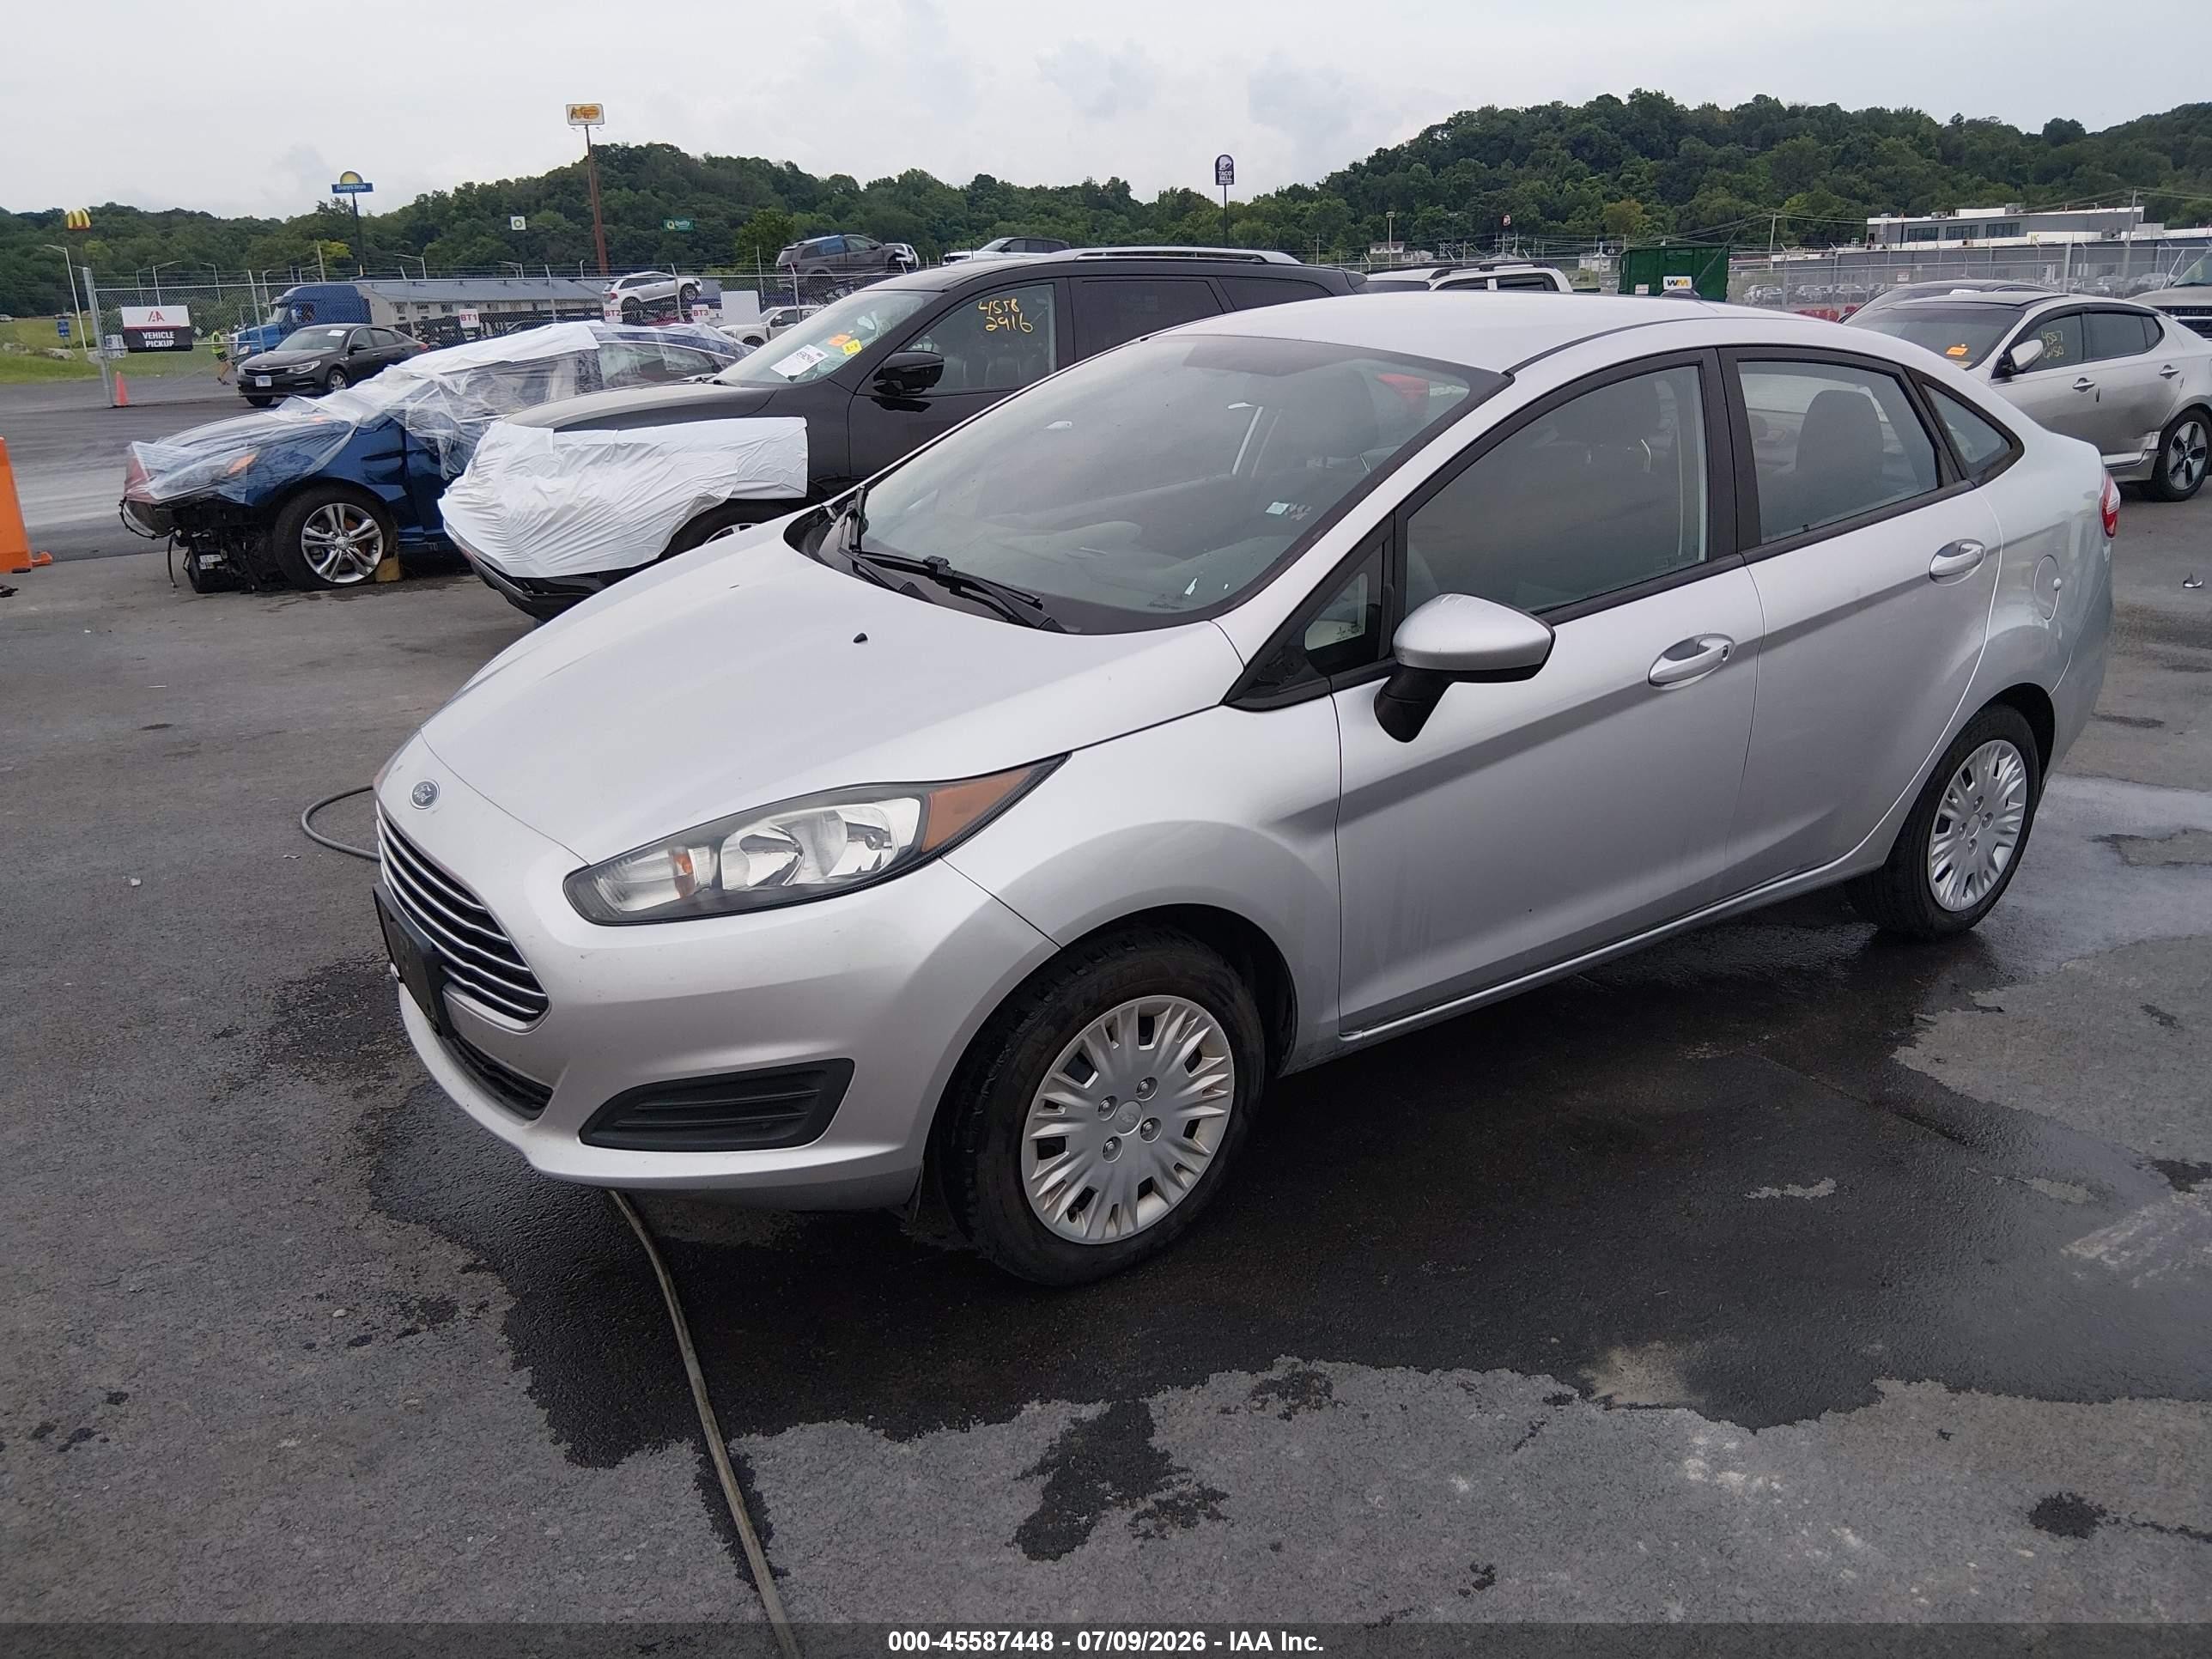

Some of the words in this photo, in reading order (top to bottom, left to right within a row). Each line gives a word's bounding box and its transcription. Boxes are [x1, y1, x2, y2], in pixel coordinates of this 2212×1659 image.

[460, 313, 477, 322] BT1
[985, 312, 1034, 333] 2916
[142, 331, 175, 340] VEHICLE
[145, 340, 175, 349] PICKUP
